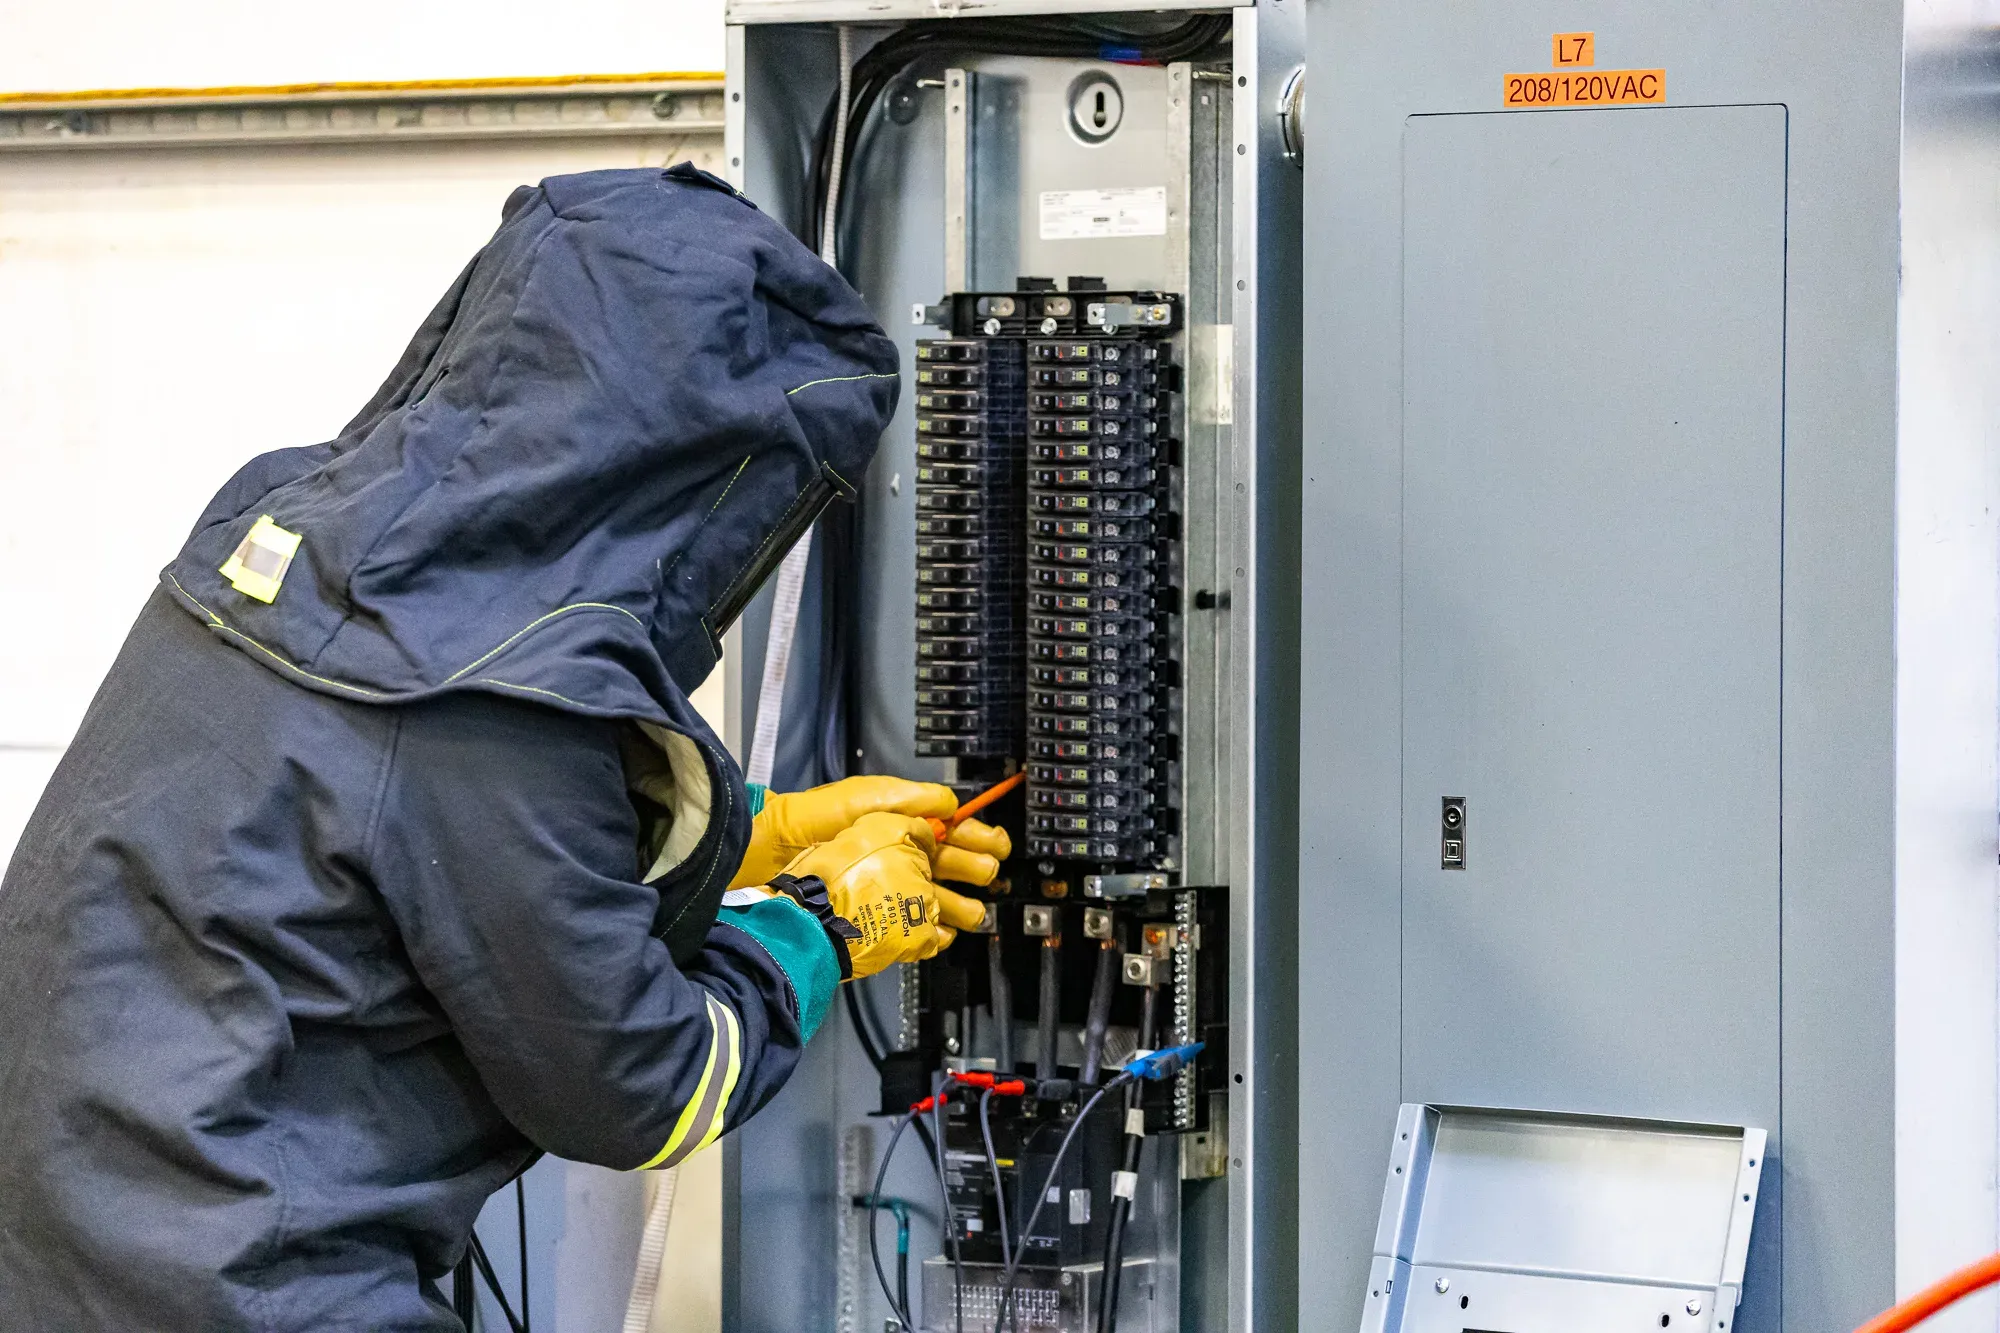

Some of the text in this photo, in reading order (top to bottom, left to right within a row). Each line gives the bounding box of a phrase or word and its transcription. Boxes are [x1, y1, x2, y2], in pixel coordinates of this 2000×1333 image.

[1559, 38, 1587, 62] L7
[1509, 74, 1658, 103] 208/120VAC
[896, 892, 910, 937] OBERON
